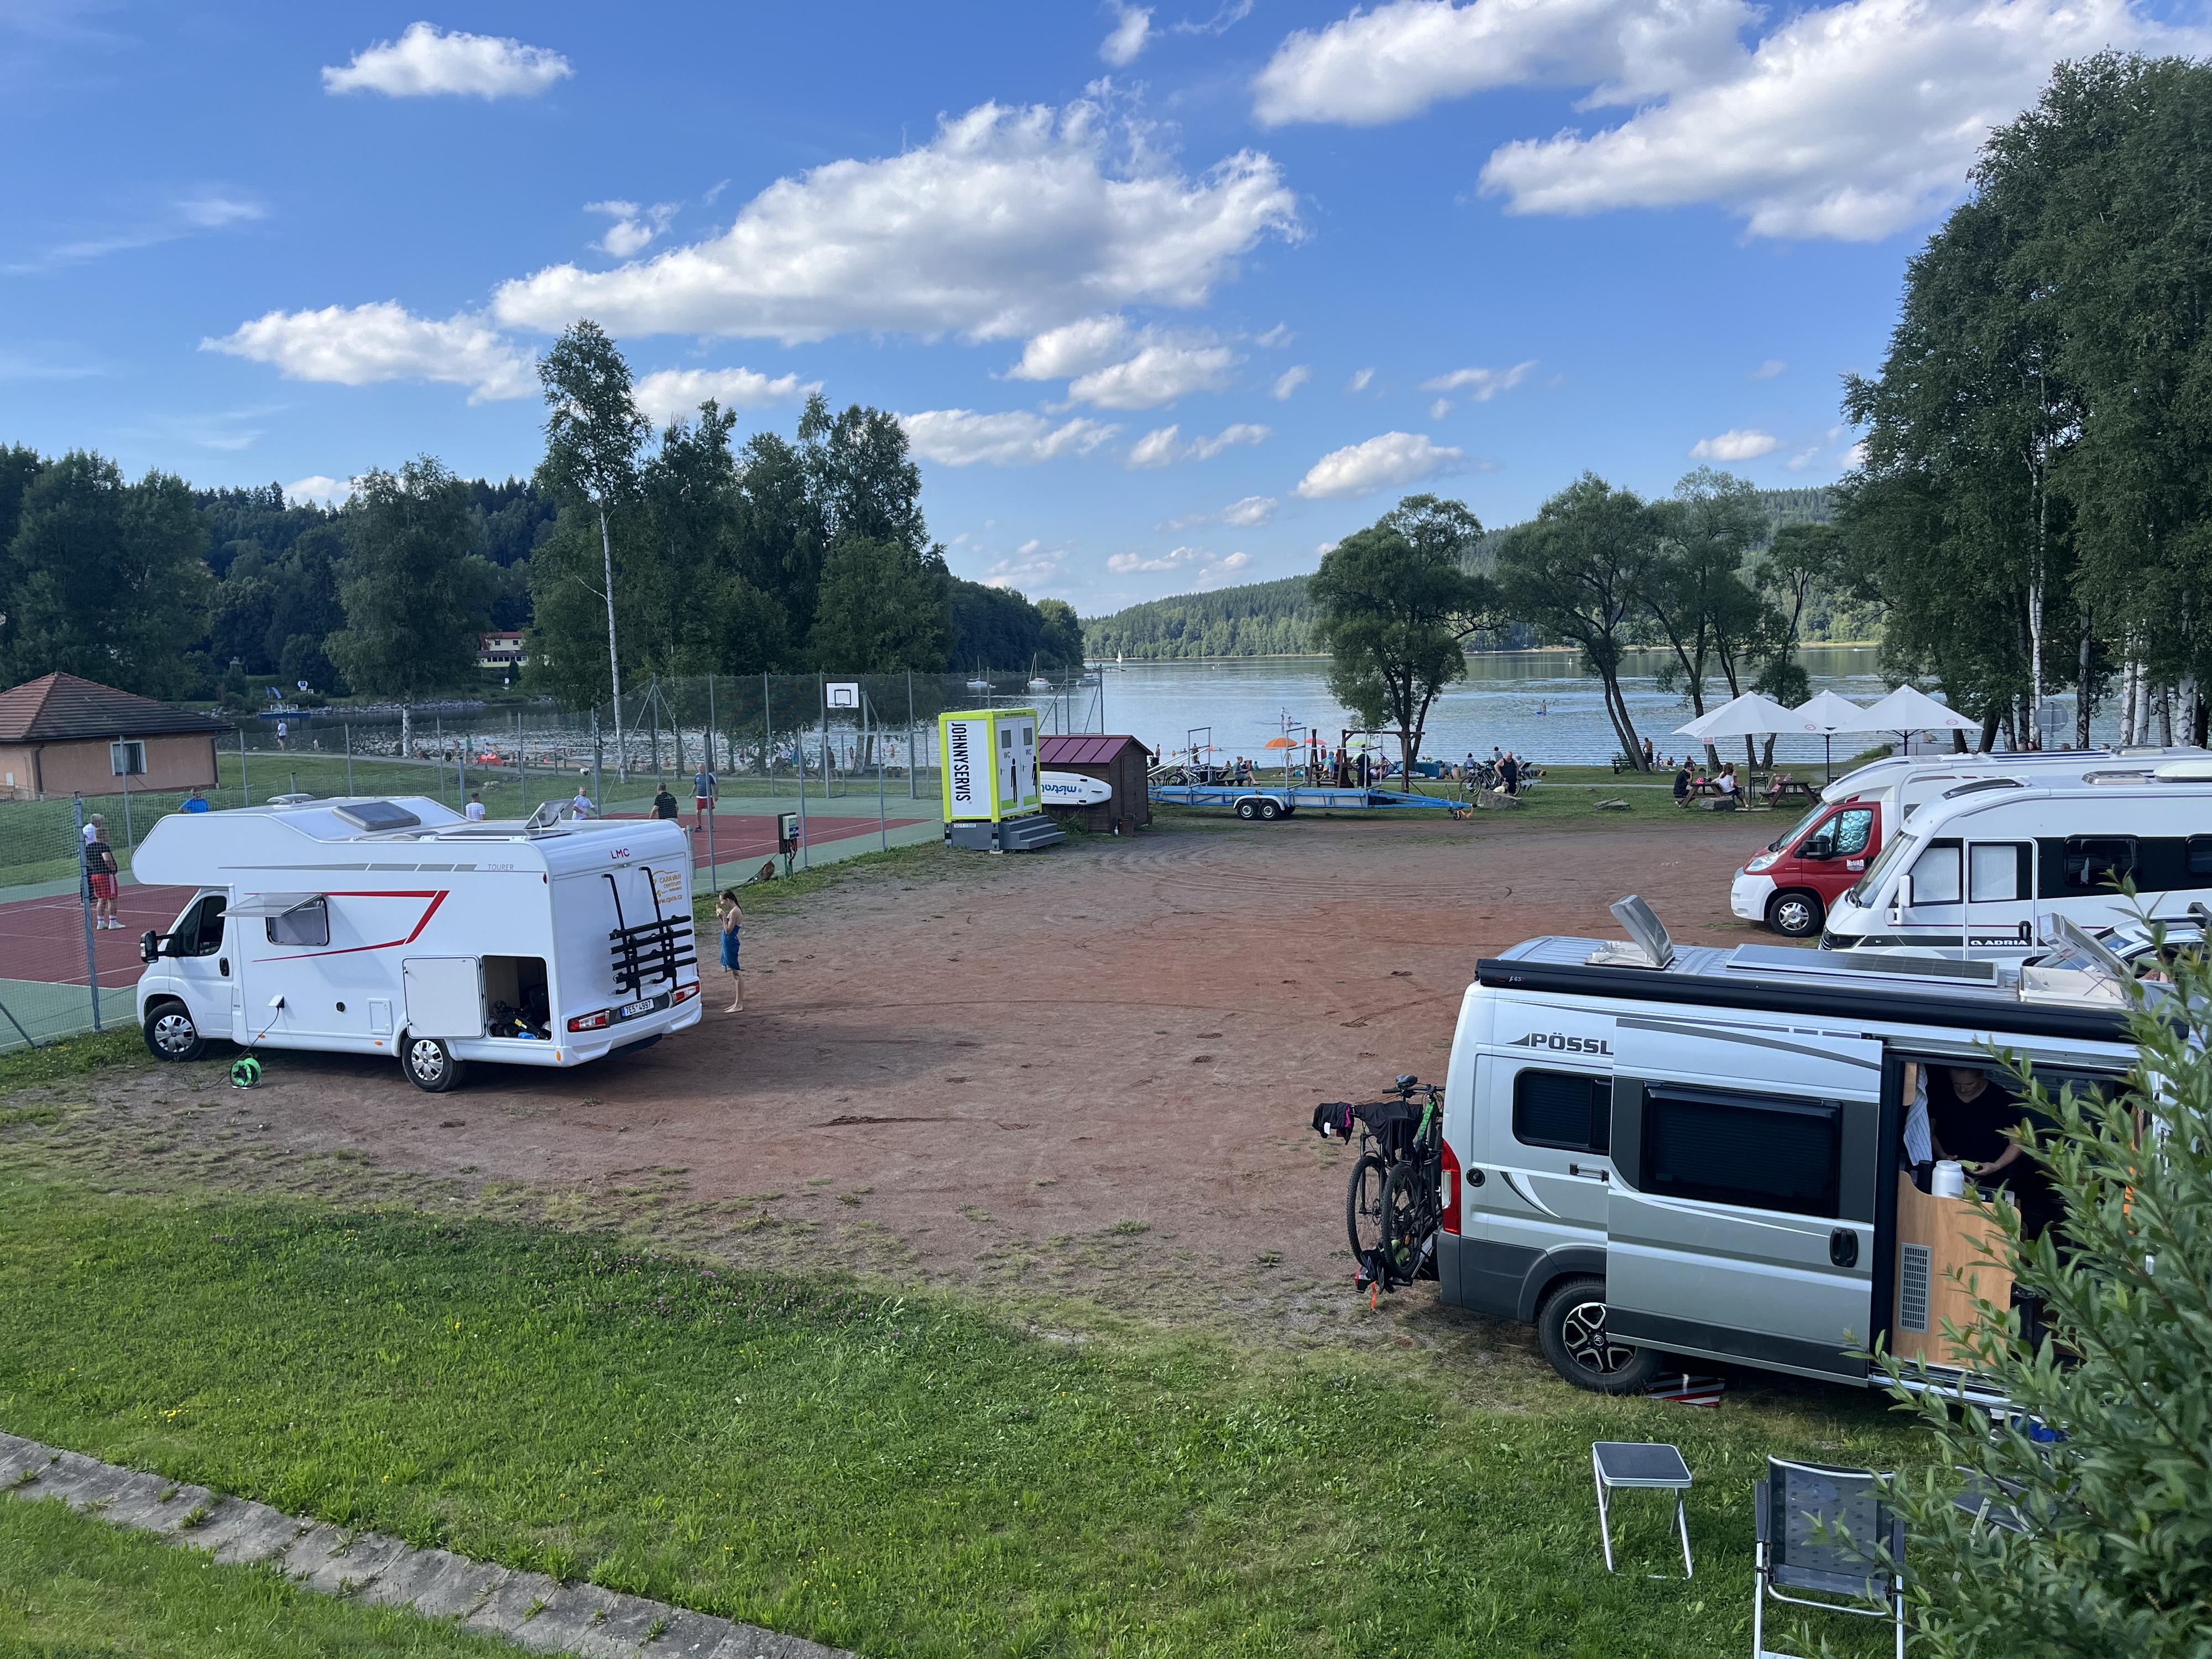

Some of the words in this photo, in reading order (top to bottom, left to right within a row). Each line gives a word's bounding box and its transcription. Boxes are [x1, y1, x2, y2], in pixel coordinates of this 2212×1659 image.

[1041, 784, 1077, 795] mistral
[610, 848, 630, 859] LMC
[659, 874, 681, 883] CARAVAN
[639, 1000, 651, 1011] 4997
[1531, 1032, 1614, 1055] PÖSSL
